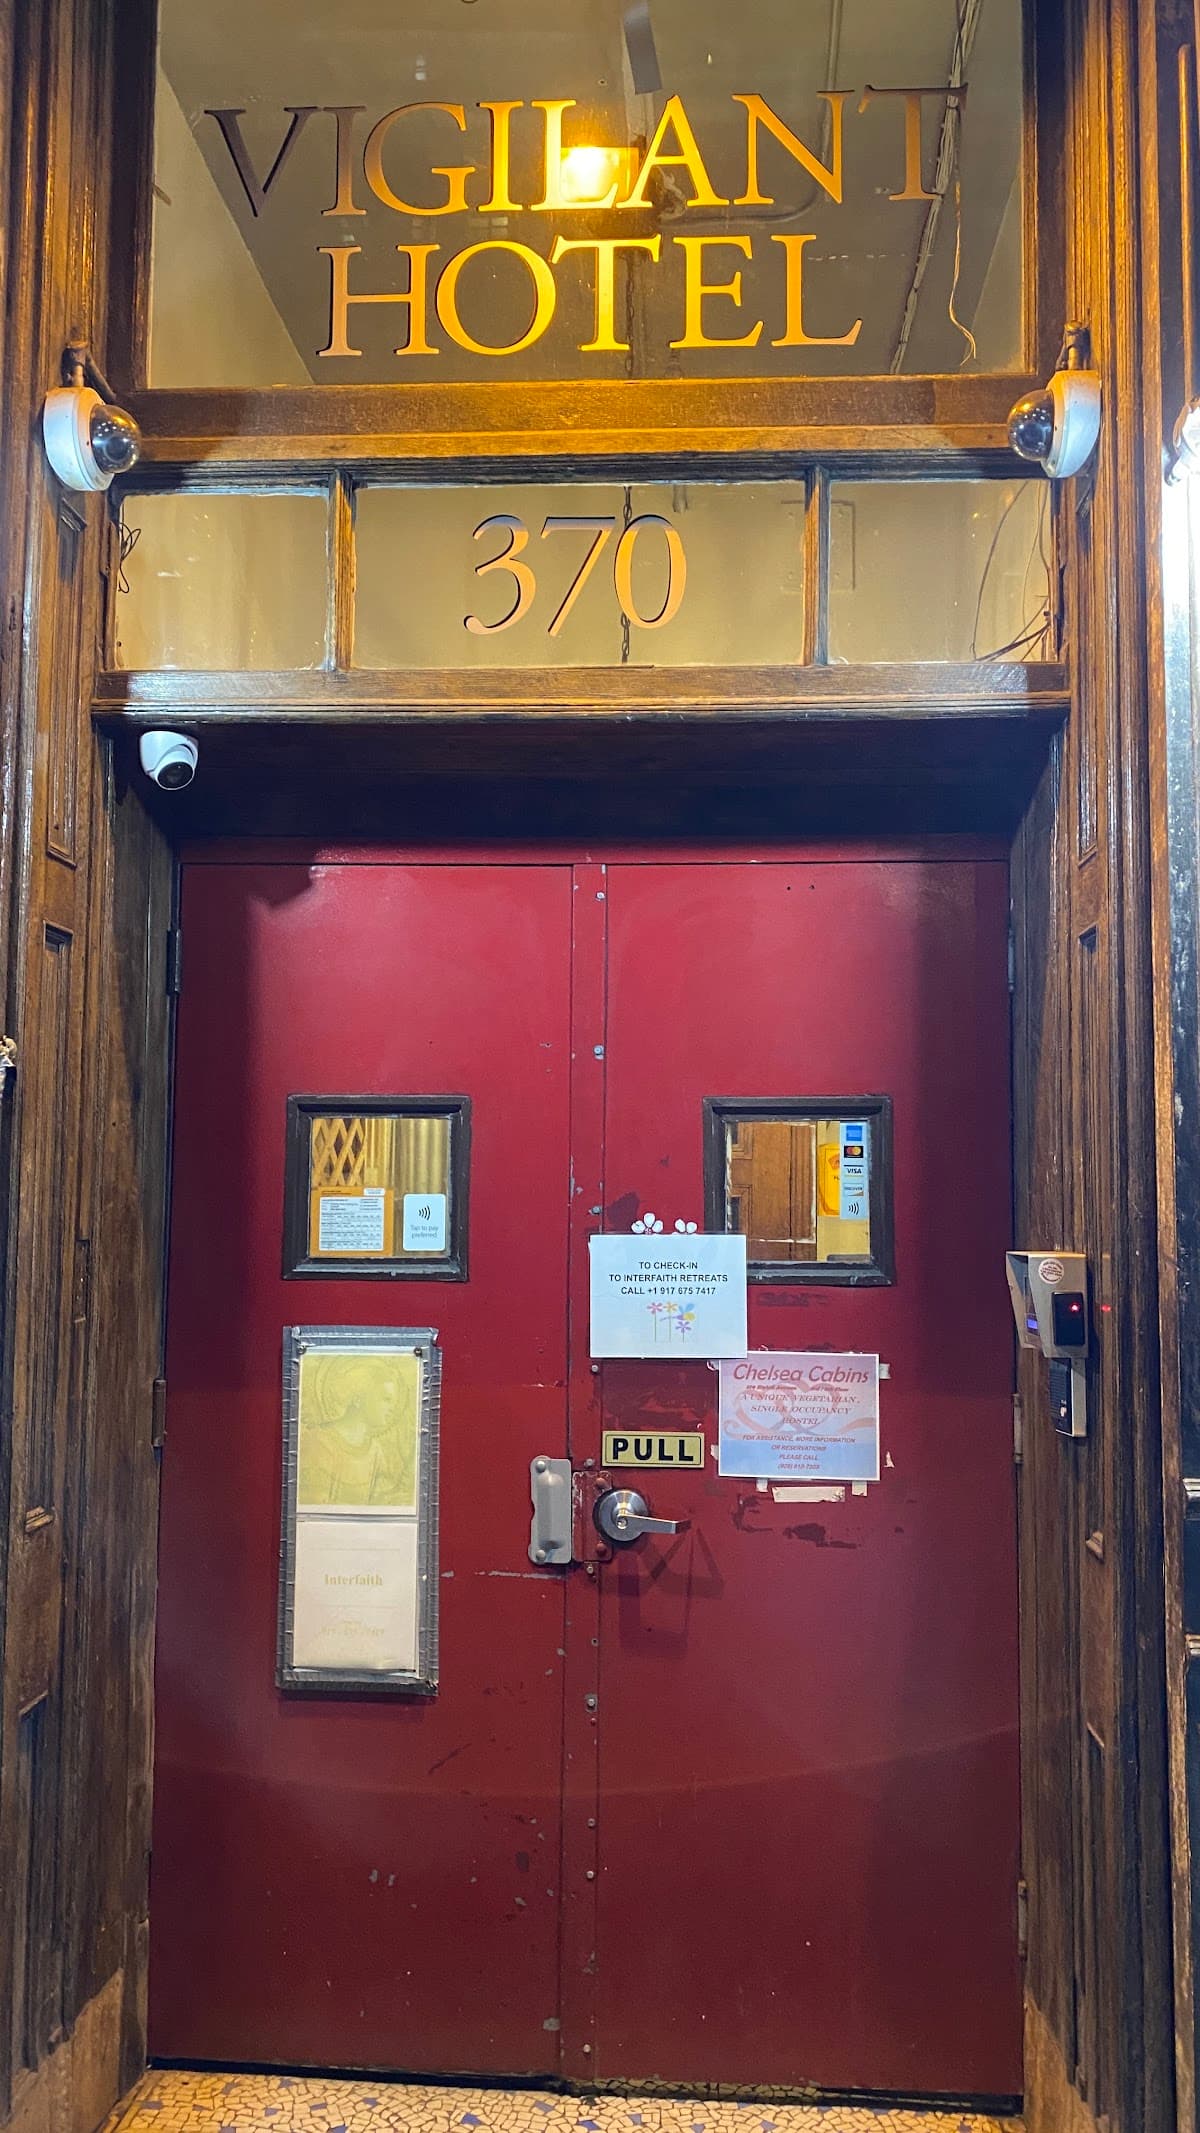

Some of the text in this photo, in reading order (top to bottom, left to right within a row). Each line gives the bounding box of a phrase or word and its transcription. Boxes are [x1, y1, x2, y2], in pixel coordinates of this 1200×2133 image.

[203, 83, 968, 217] VIGILANT
[316, 234, 863, 357] HOTEL
[462, 514, 687, 637] 370
[639, 1261, 698, 1270] TO CHECK-IN
[609, 1274, 728, 1282] TO INTERFAITH RETREATS
[621, 1287, 716, 1295] CALL +1 917 675 7417
[733, 1363, 870, 1383] Chelsea Cabins
[749, 1393, 788, 1401] UNIQUE
[750, 1404, 852, 1415] SINGLE OCCUPANCY
[612, 1438, 694, 1462] PULL
[324, 1573, 383, 1586] Interfaith
